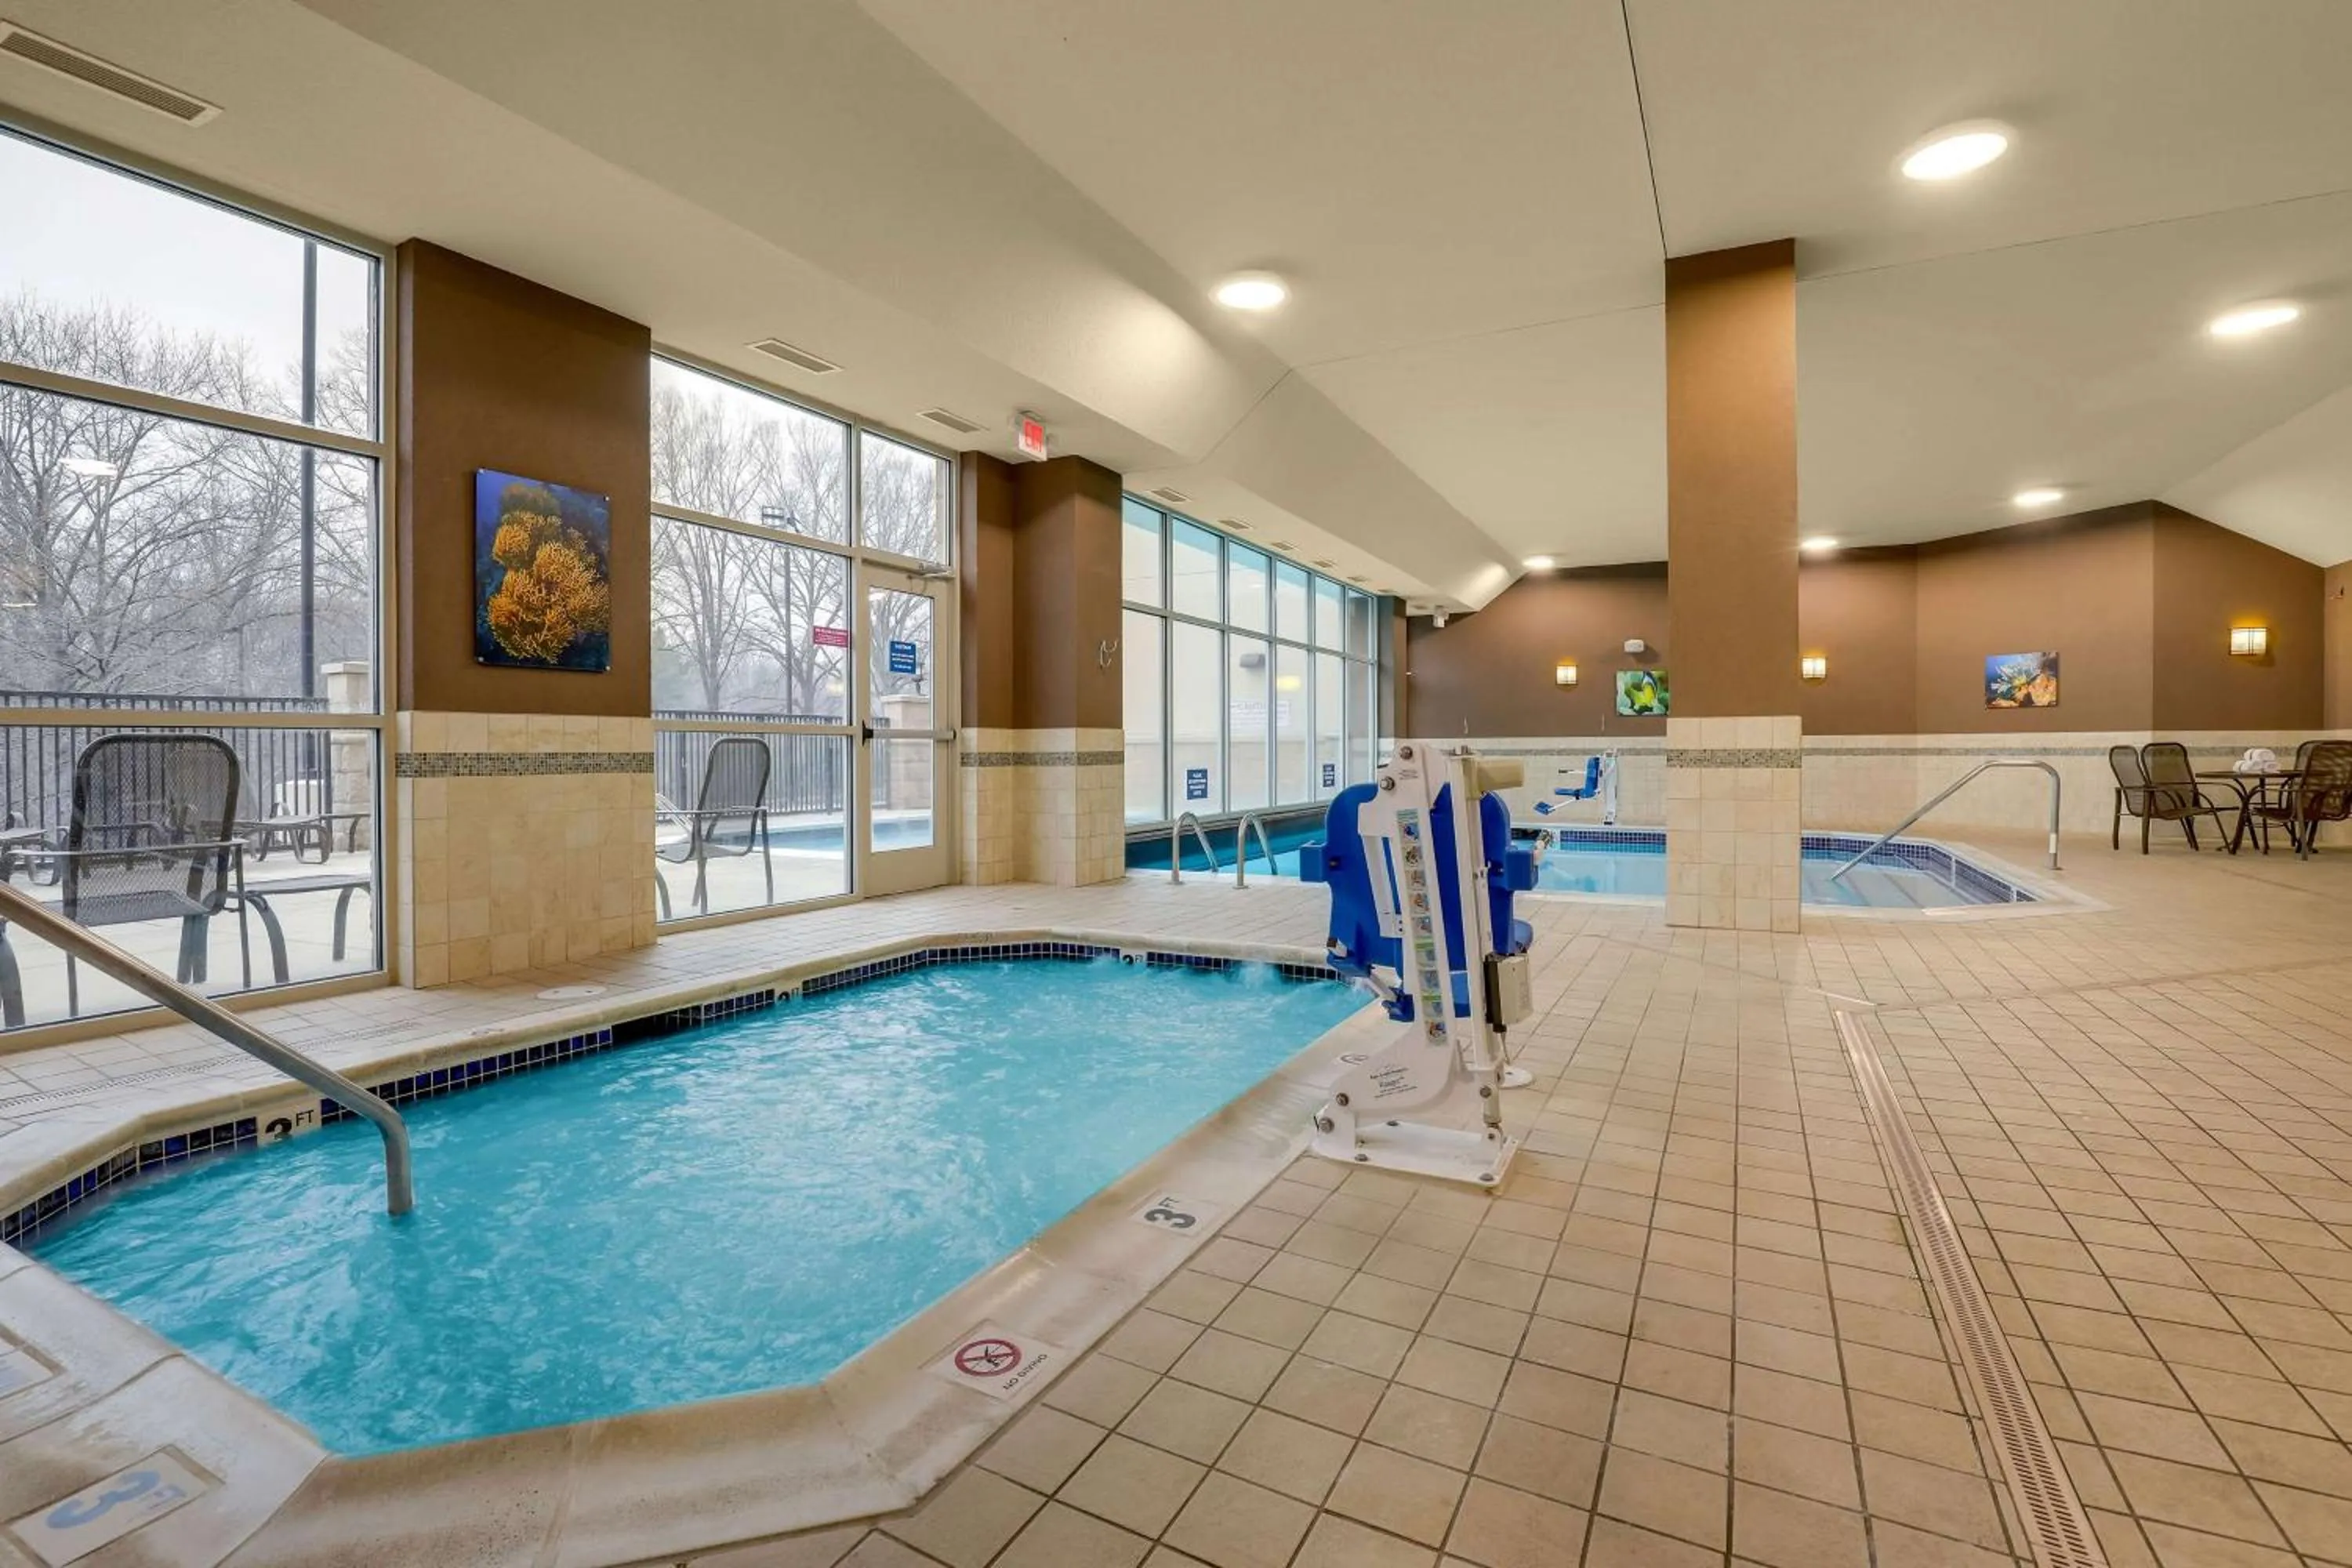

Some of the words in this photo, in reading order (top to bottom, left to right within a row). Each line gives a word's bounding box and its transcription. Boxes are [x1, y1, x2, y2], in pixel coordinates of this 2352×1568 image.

[296, 1109, 314, 1127] FT
[1158, 1196, 1181, 1209] FT
[1144, 1208, 1196, 1229] 3
[1003, 1377, 1018, 1390] NO
[1017, 1354, 1048, 1377] DIVING
[45, 1471, 161, 1529] 3
